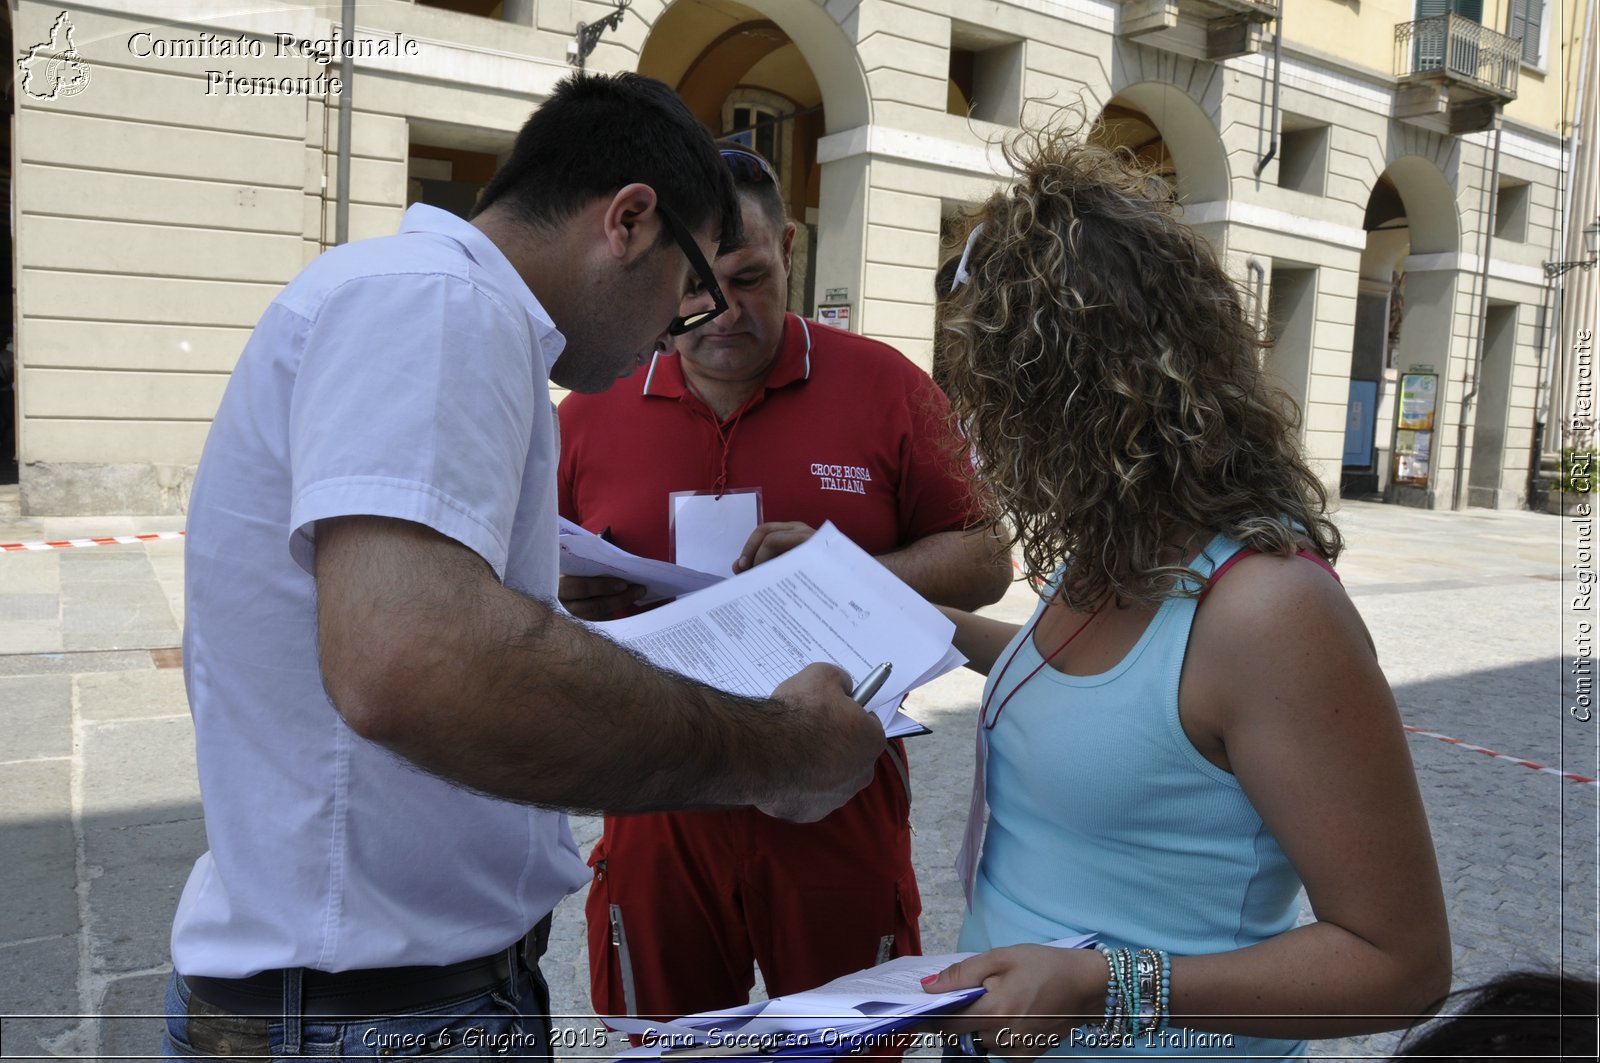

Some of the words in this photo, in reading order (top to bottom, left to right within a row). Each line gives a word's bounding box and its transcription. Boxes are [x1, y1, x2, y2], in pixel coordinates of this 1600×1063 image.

[811, 463, 842, 478] CROCE
[843, 465, 872, 481] ROSSA
[820, 477, 866, 494] ITALIANA
